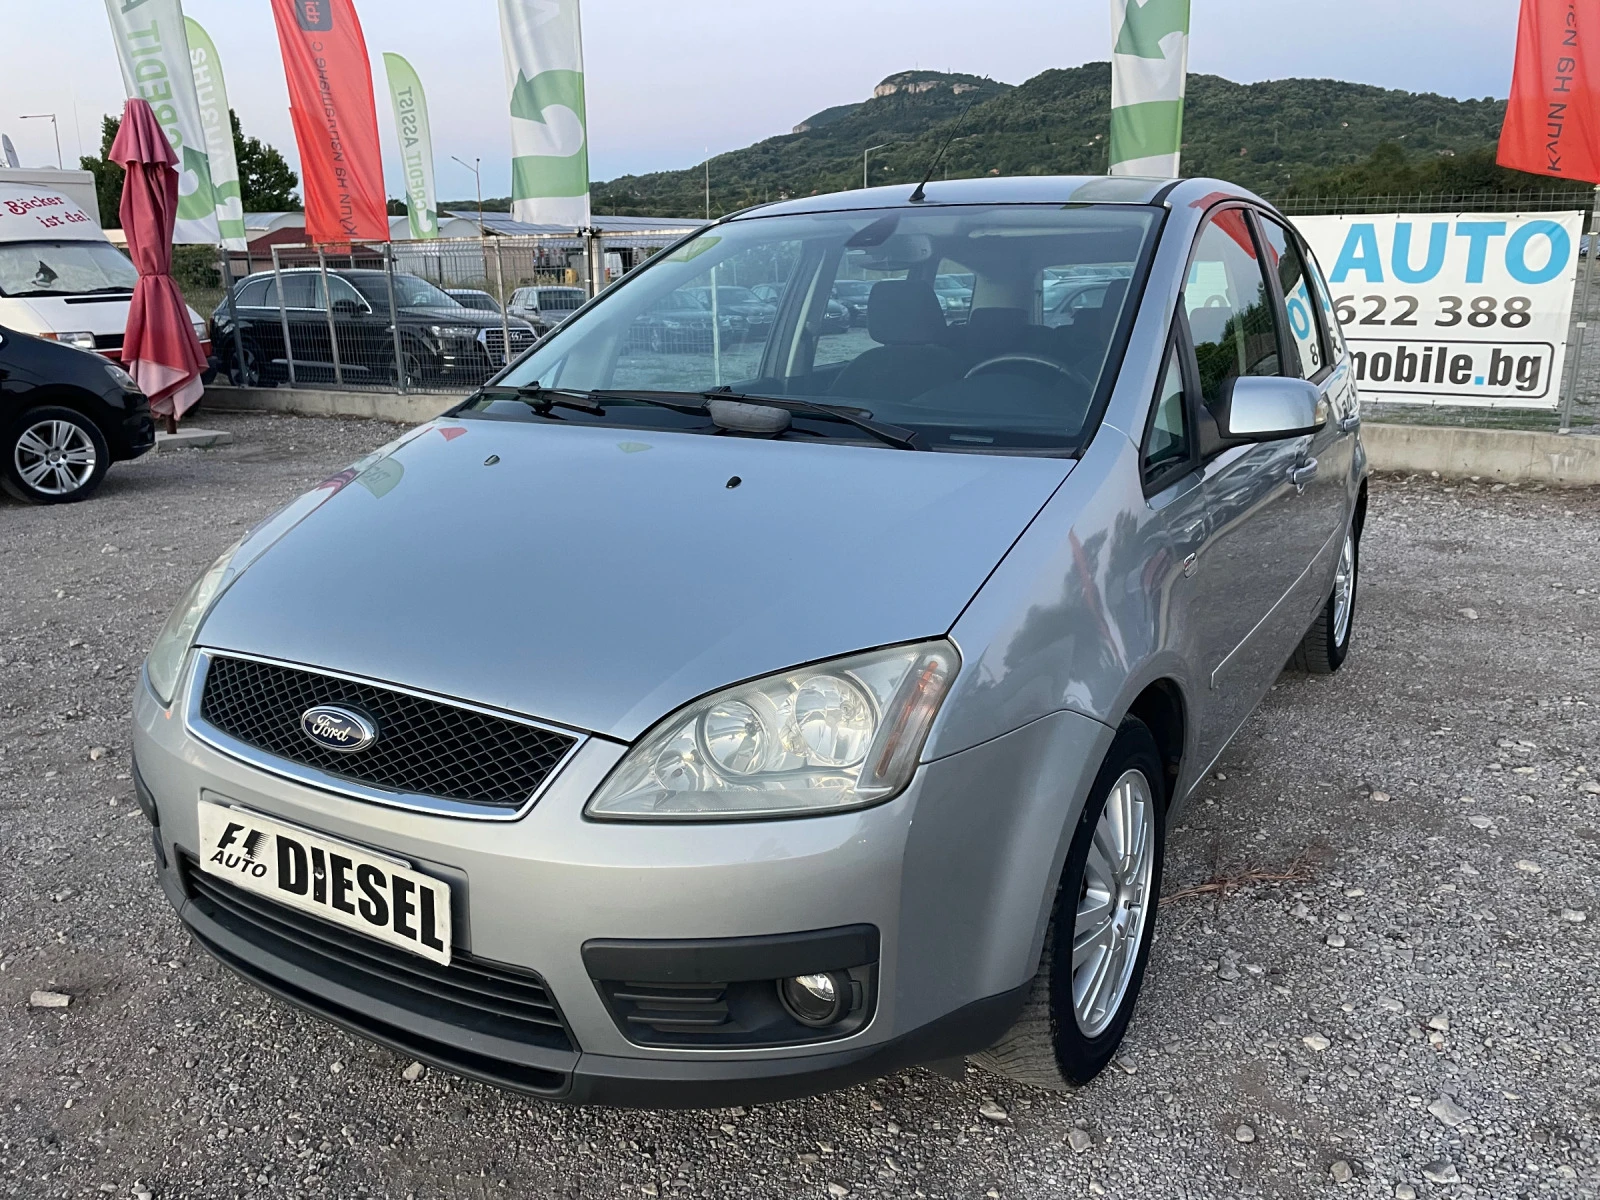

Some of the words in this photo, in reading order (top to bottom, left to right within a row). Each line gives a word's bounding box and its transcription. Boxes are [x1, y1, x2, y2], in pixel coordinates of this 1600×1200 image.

[3, 196, 65, 215] Bäcker
[36, 215, 65, 228] ist
[65, 209, 91, 222] da!
[1328, 220, 1571, 285] AUTO
[1333, 295, 1419, 326] 622
[1434, 295, 1532, 329] 388
[312, 714, 351, 742] Ford
[210, 850, 267, 878] AUTO
[276, 834, 444, 953] DIESEL
